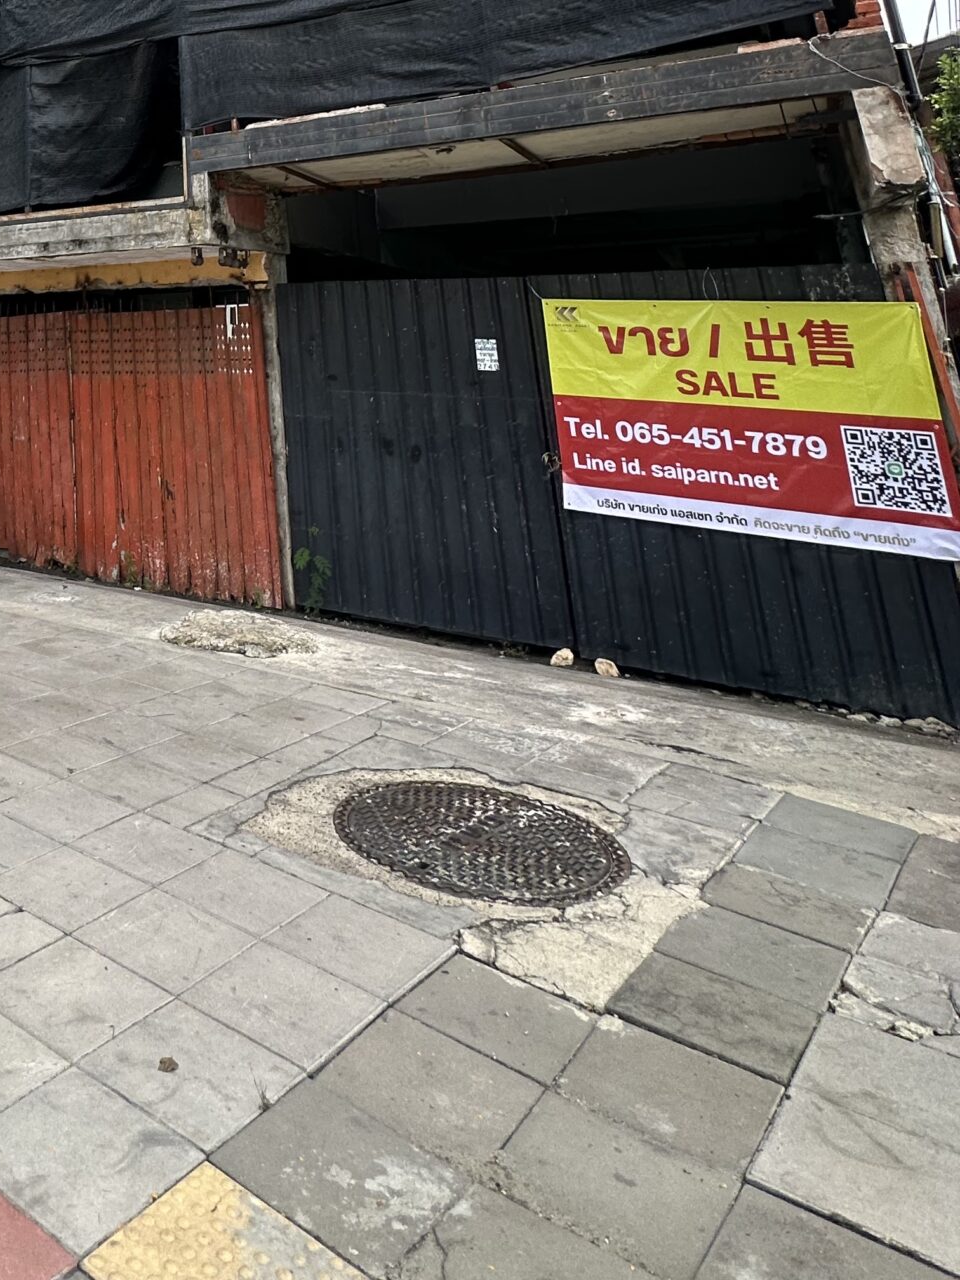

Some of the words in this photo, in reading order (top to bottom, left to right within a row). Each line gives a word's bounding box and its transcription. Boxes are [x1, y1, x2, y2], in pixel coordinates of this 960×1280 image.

[598, 325, 690, 358] ขาย
[744, 318, 855, 369] 出售
[675, 369, 780, 401] SALE
[563, 416, 610, 440] Tel.
[615, 420, 828, 460] 065-451-7879
[572, 452, 617, 474] Line
[621, 457, 646, 476] id.
[651, 463, 780, 491] saiparn.net
[597, 498, 626, 511] บริษัท
[628, 503, 668, 516] ขายเก่ง
[716, 512, 748, 527] จำกัด
[814, 524, 851, 540] คิดถึง
